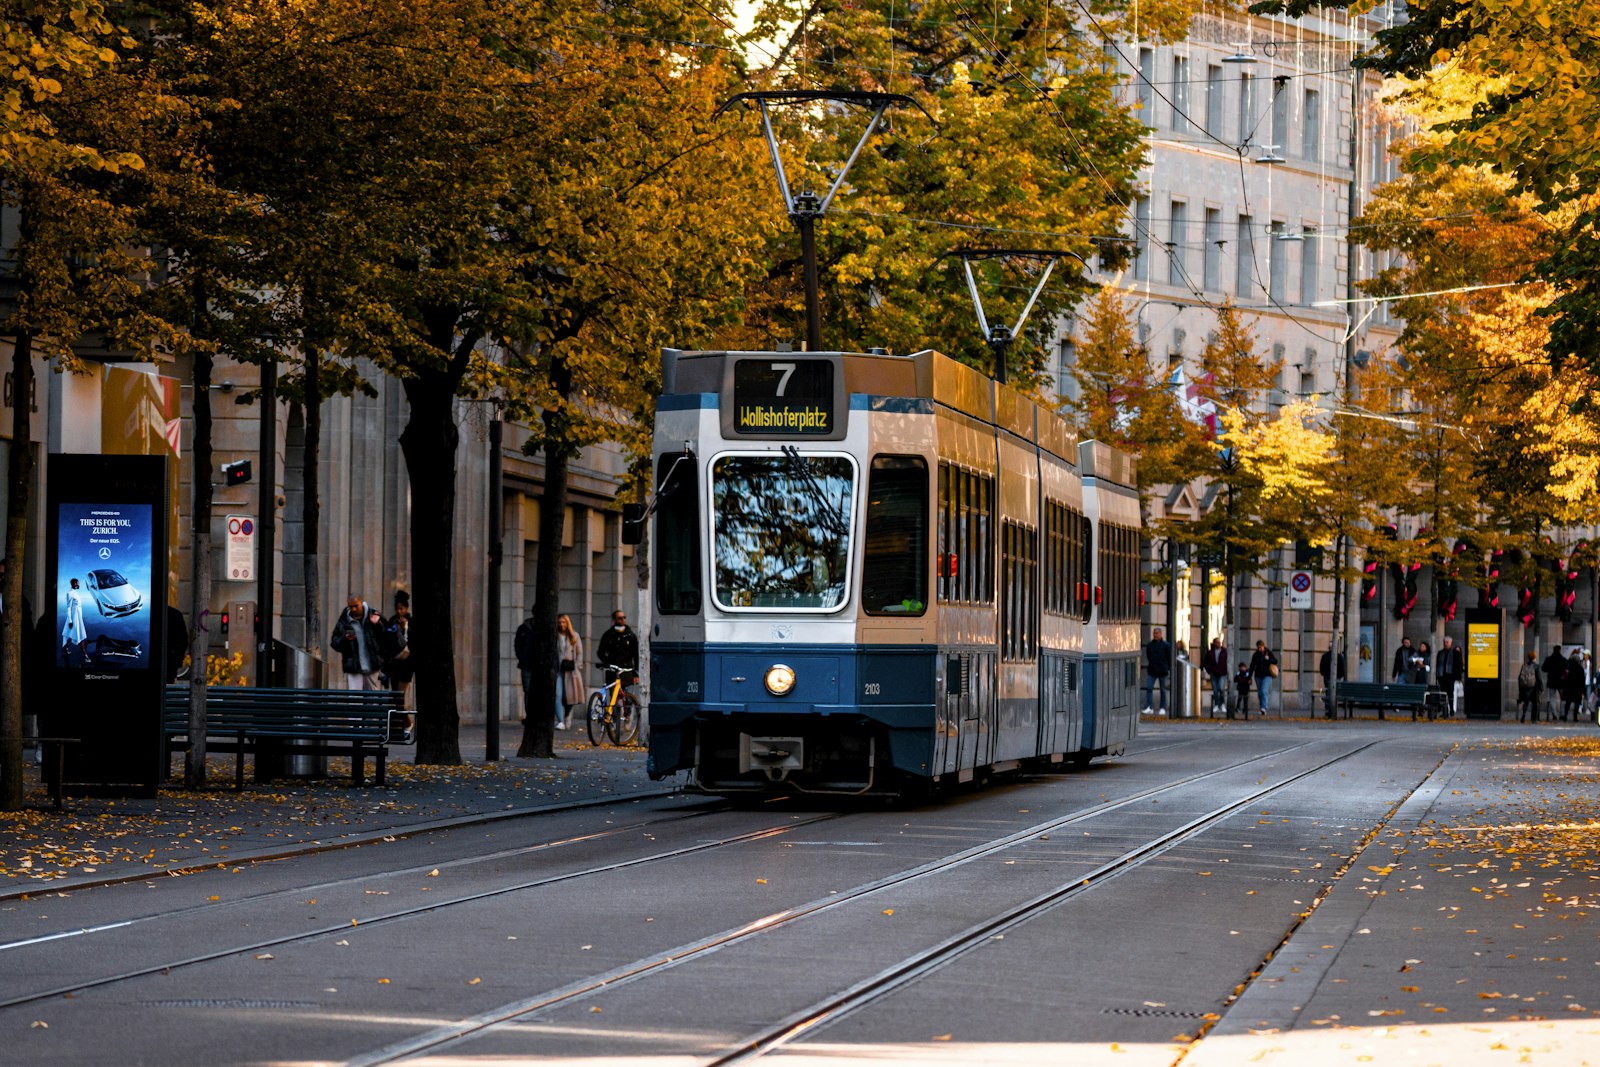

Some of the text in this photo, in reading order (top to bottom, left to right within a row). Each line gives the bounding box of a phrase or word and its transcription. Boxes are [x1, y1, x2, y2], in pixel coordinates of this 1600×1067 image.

[771, 363, 796, 396] 7
[740, 406, 827, 431] Wollishoferplatz
[116, 519, 131, 527] YOU,
[92, 526, 118, 534] ZURICH.
[865, 683, 880, 695] 2103
